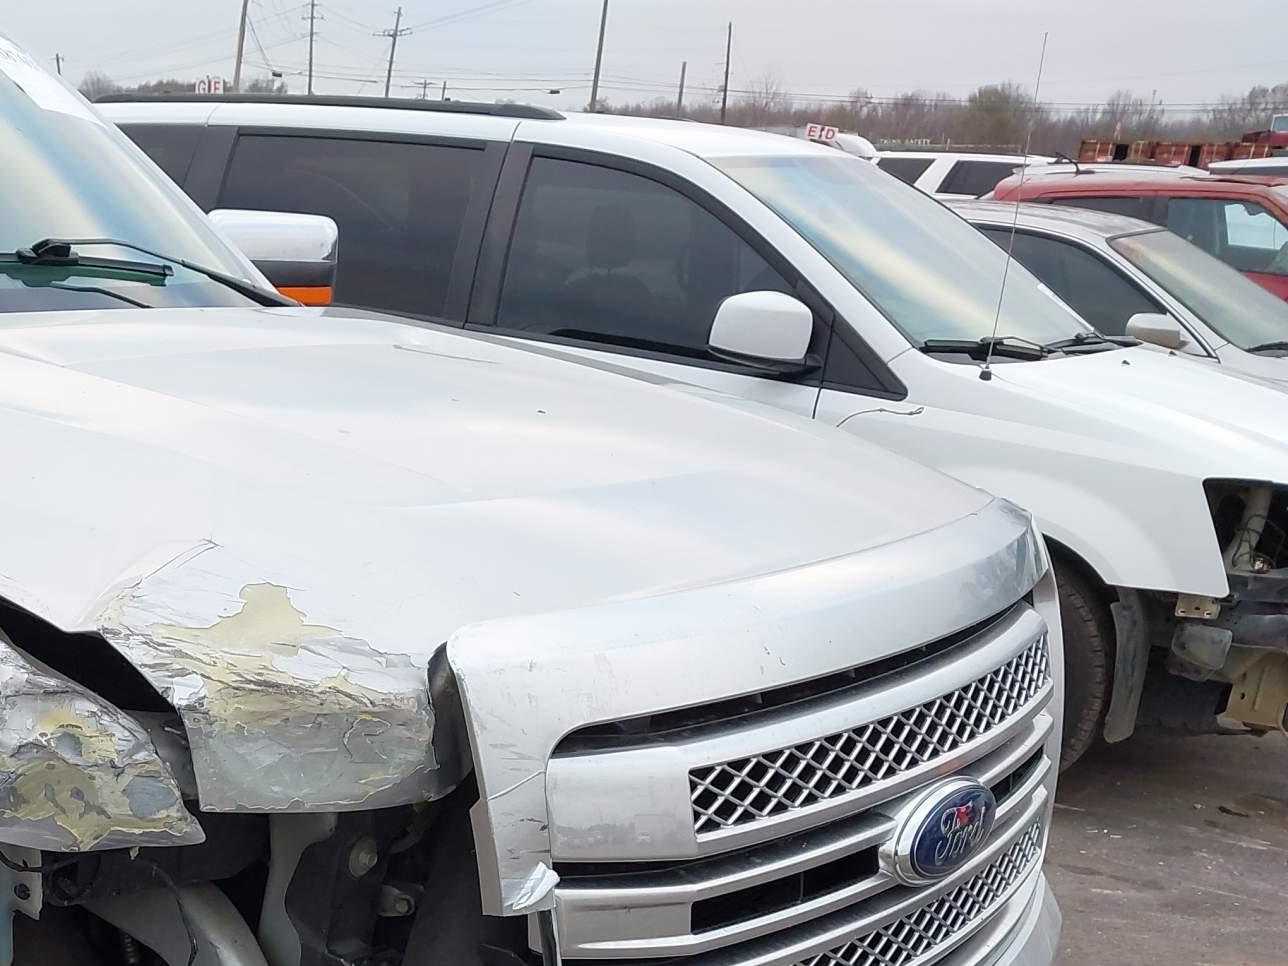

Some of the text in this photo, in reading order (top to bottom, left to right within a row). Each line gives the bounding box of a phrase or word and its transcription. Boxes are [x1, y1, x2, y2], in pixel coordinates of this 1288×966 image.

[807, 125, 835, 140] E D
[934, 800, 987, 866] Ford
